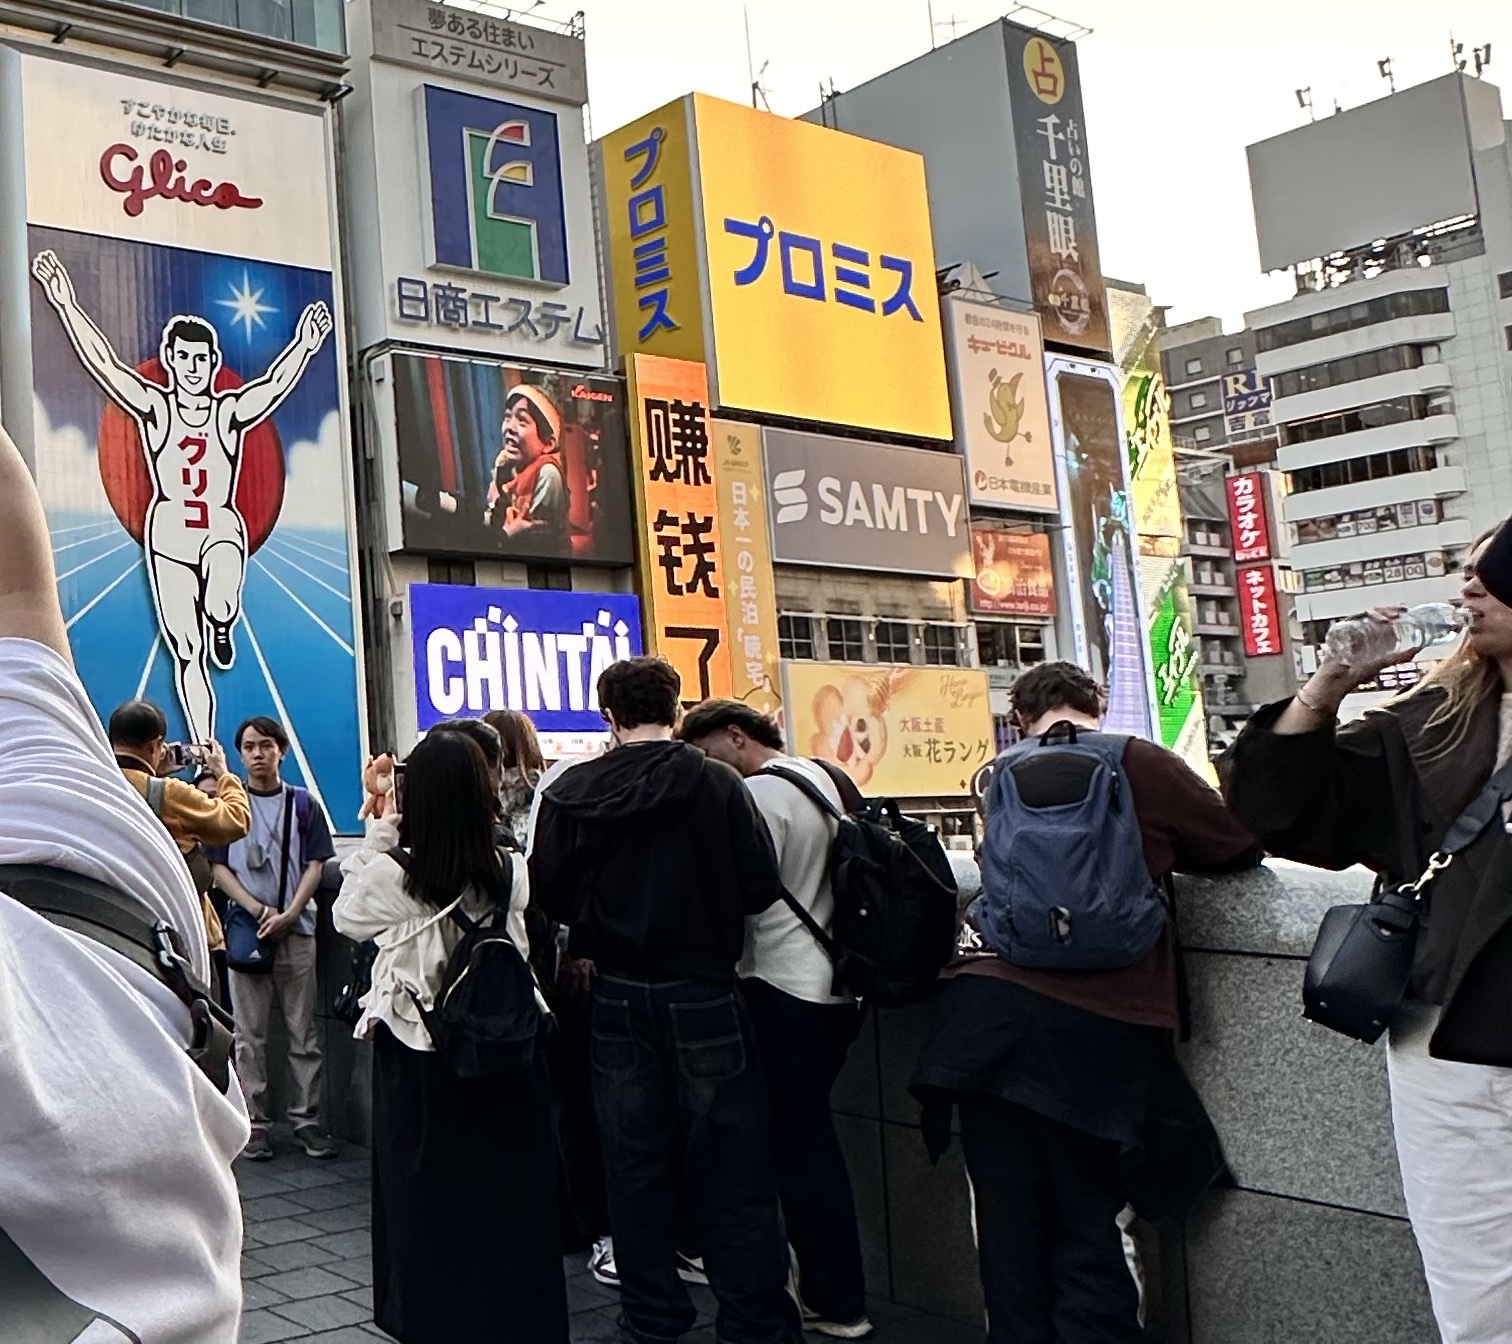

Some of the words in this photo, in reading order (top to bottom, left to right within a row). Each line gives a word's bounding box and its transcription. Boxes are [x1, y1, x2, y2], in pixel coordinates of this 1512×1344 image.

[412, 37, 555, 90] エステムシリーズ
[427, 7, 536, 51] 夢ある住まい
[1031, 41, 1058, 98] 占
[100, 143, 264, 217] Glico
[1036, 114, 1080, 262] 千里眼
[624, 126, 681, 344] プロミス
[724, 215, 926, 323] プロミス
[397, 276, 607, 345] 日商エステム
[177, 431, 211, 530] グリコ
[818, 476, 962, 538] SAMTY
[1233, 477, 1262, 548] カラオケ
[644, 399, 721, 702] 赚钱了
[1245, 570, 1276, 655] ネットカフェ
